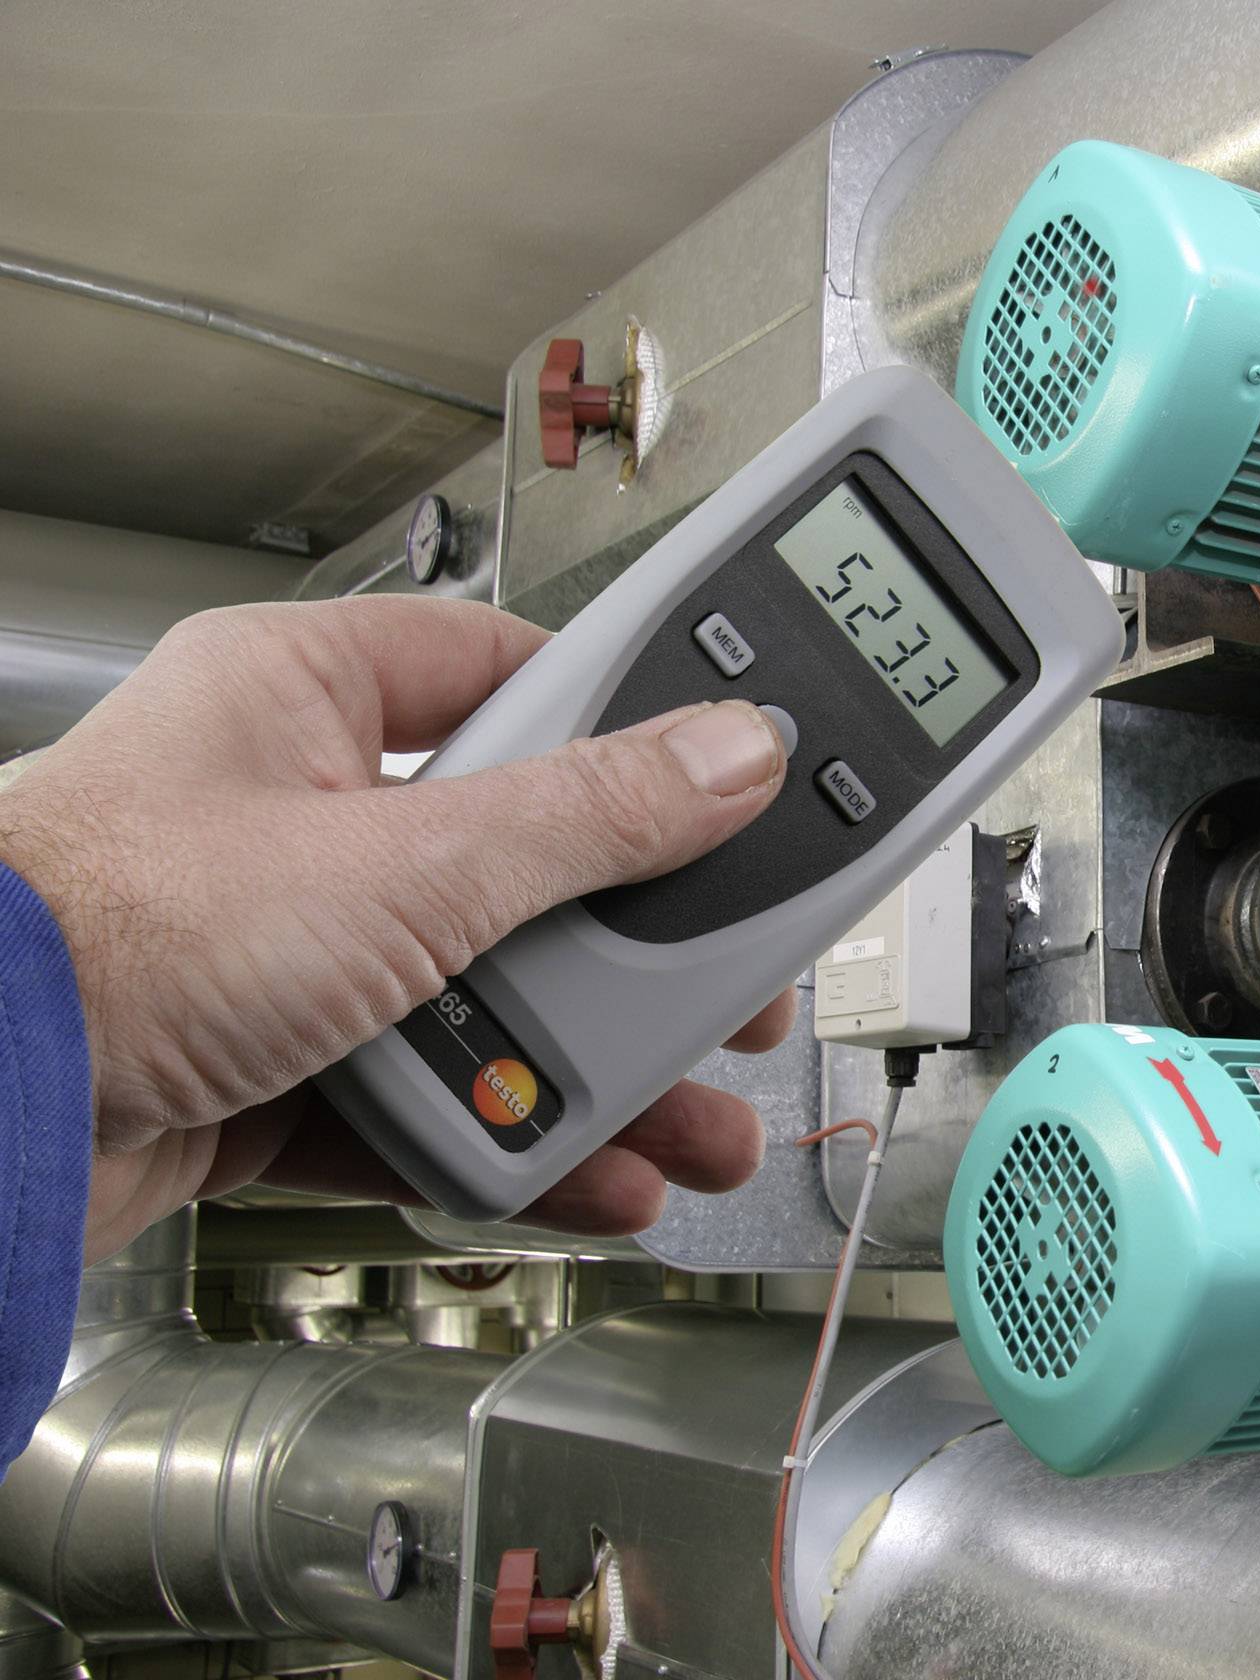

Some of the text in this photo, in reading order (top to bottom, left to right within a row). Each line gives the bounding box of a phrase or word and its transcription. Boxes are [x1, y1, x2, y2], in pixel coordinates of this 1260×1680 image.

[841, 495, 862, 520] rpm
[711, 625, 745, 664] MEM
[815, 551, 960, 708] 523.3
[829, 769, 870, 817] MODE
[434, 986, 473, 1026] 65
[1047, 1053, 1060, 1074] 2
[482, 1063, 529, 1119] testo
